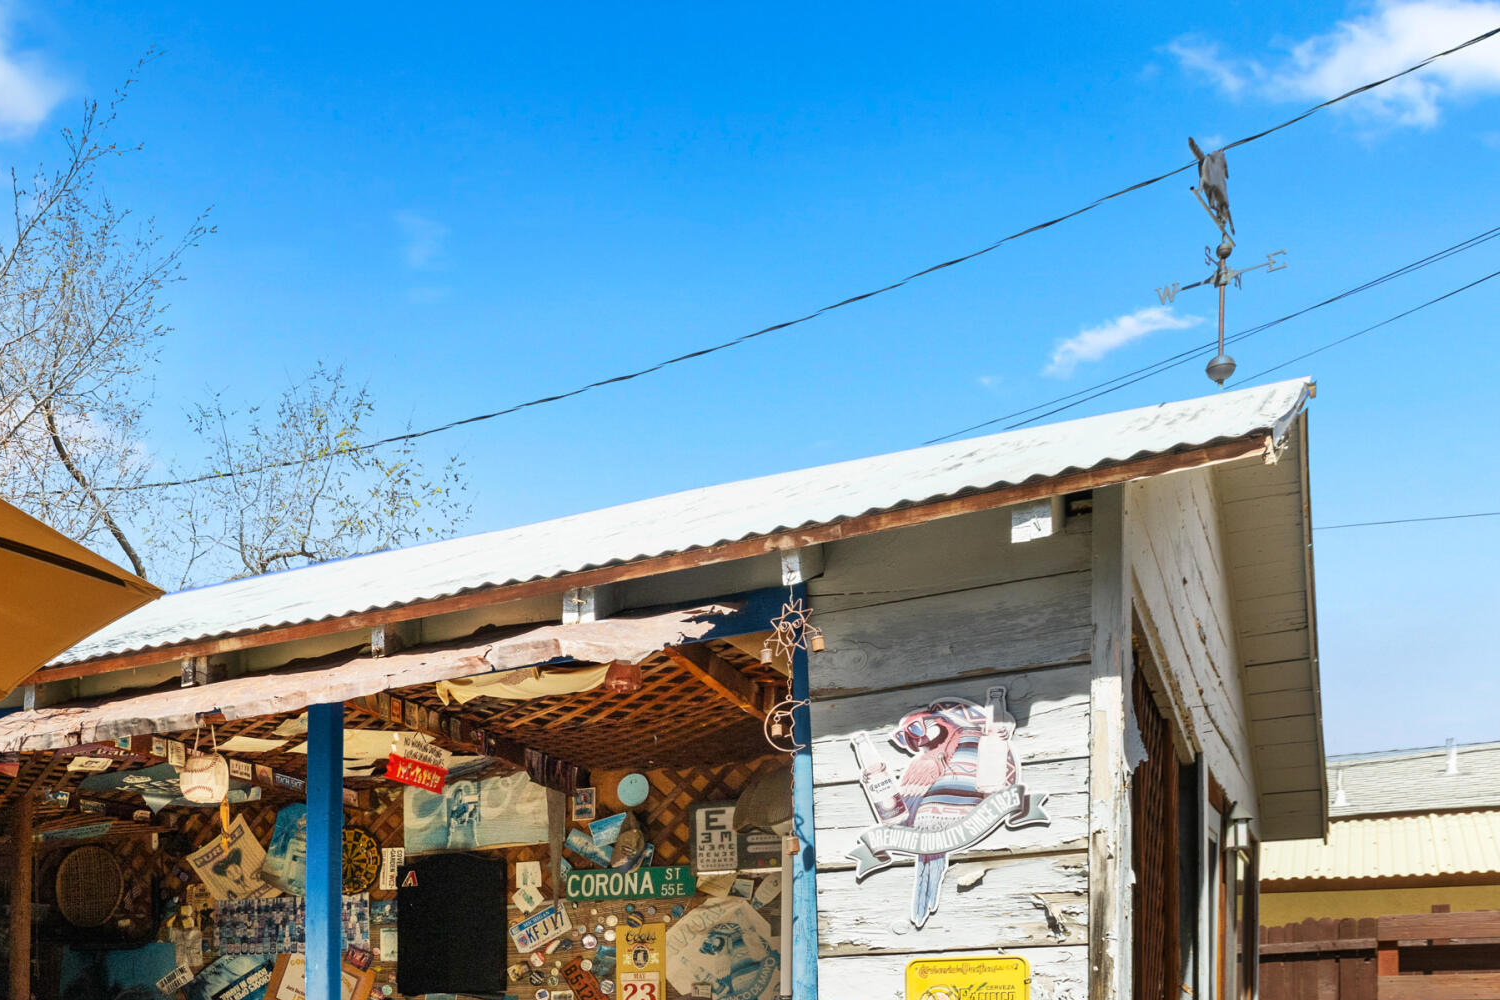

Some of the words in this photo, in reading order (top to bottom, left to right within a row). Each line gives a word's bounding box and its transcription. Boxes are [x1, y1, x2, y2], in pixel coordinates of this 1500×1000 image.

[869, 778, 892, 792] Corona
[867, 828, 920, 851] BREWING
[920, 824, 970, 851] QUALITY
[963, 803, 998, 835] SINCE
[993, 788, 1021, 815] 1925
[567, 871, 655, 898] CORONA
[665, 867, 681, 881] ST
[522, 910, 551, 928] MICHIGAN
[625, 929, 657, 945] Coors
[750, 981, 764, 997] DE
[760, 956, 776, 989] MAYO
